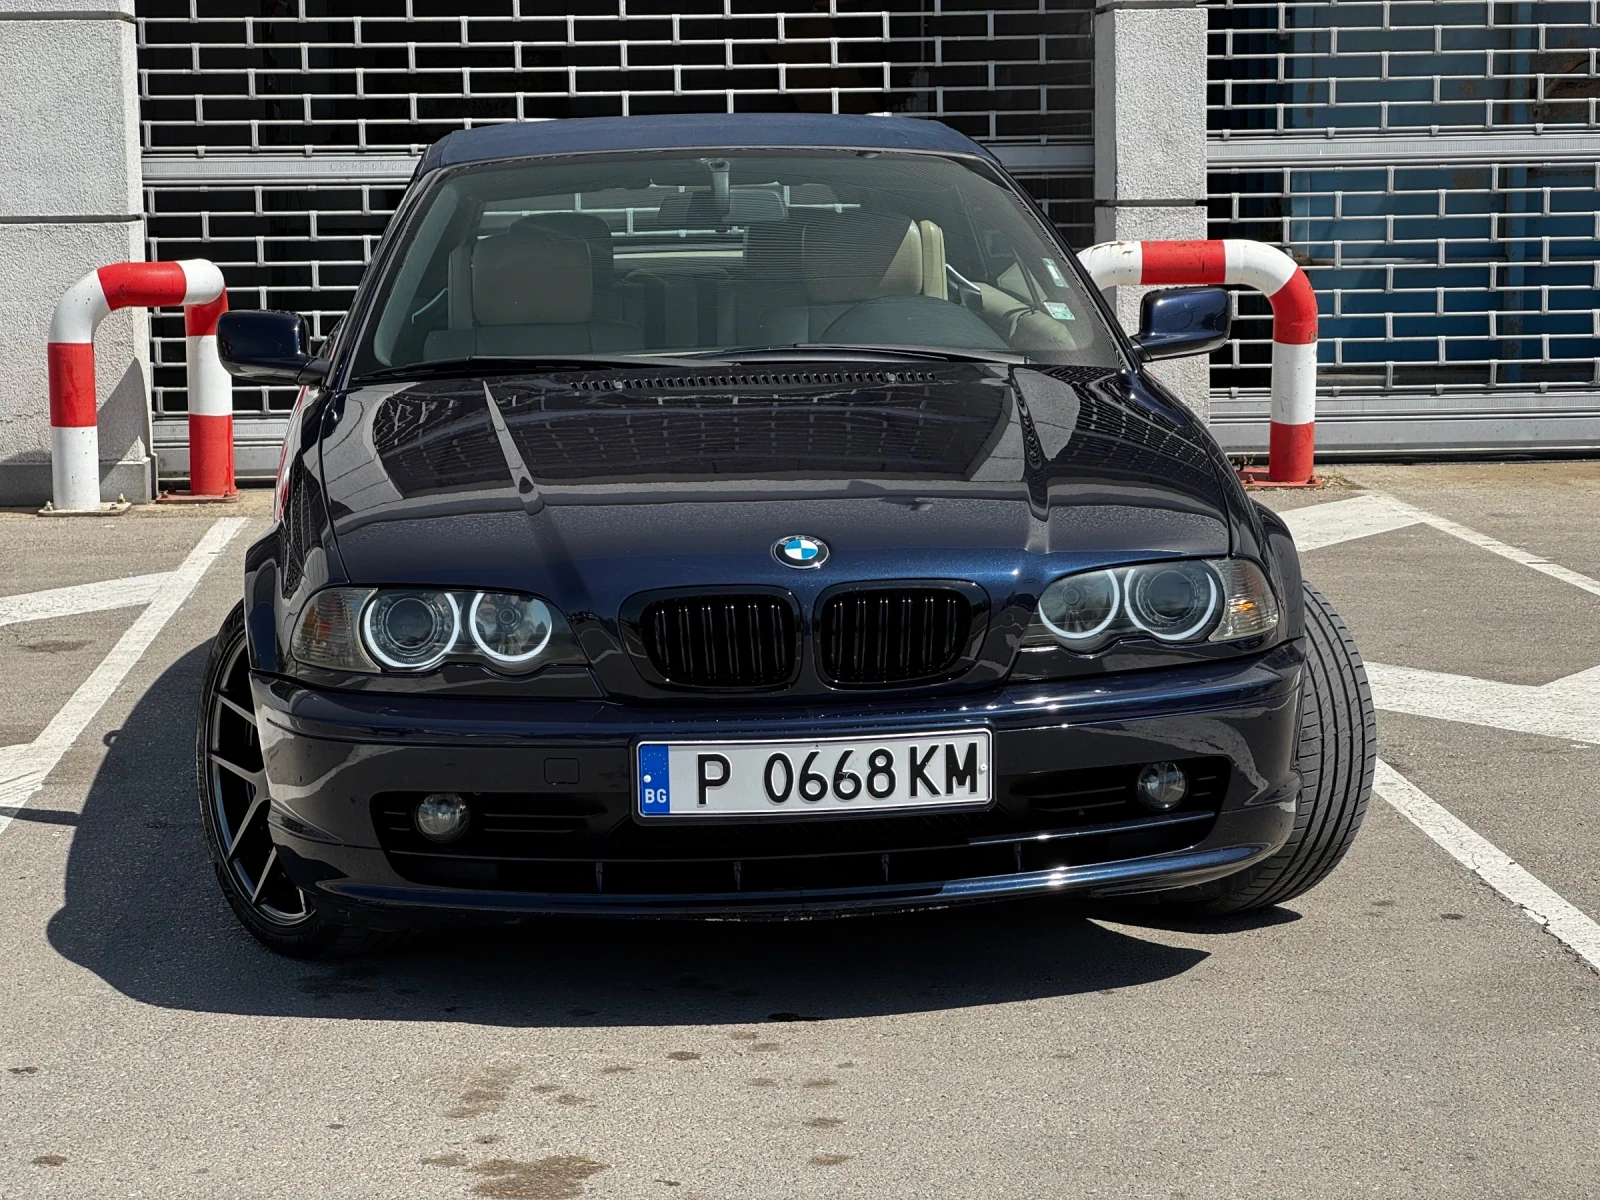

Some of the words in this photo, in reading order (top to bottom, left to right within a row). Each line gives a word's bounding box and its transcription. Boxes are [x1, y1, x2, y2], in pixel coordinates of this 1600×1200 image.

[697, 752, 731, 805] P
[764, 748, 896, 803] 0668
[910, 742, 978, 797] KM
[645, 788, 667, 803] BG
